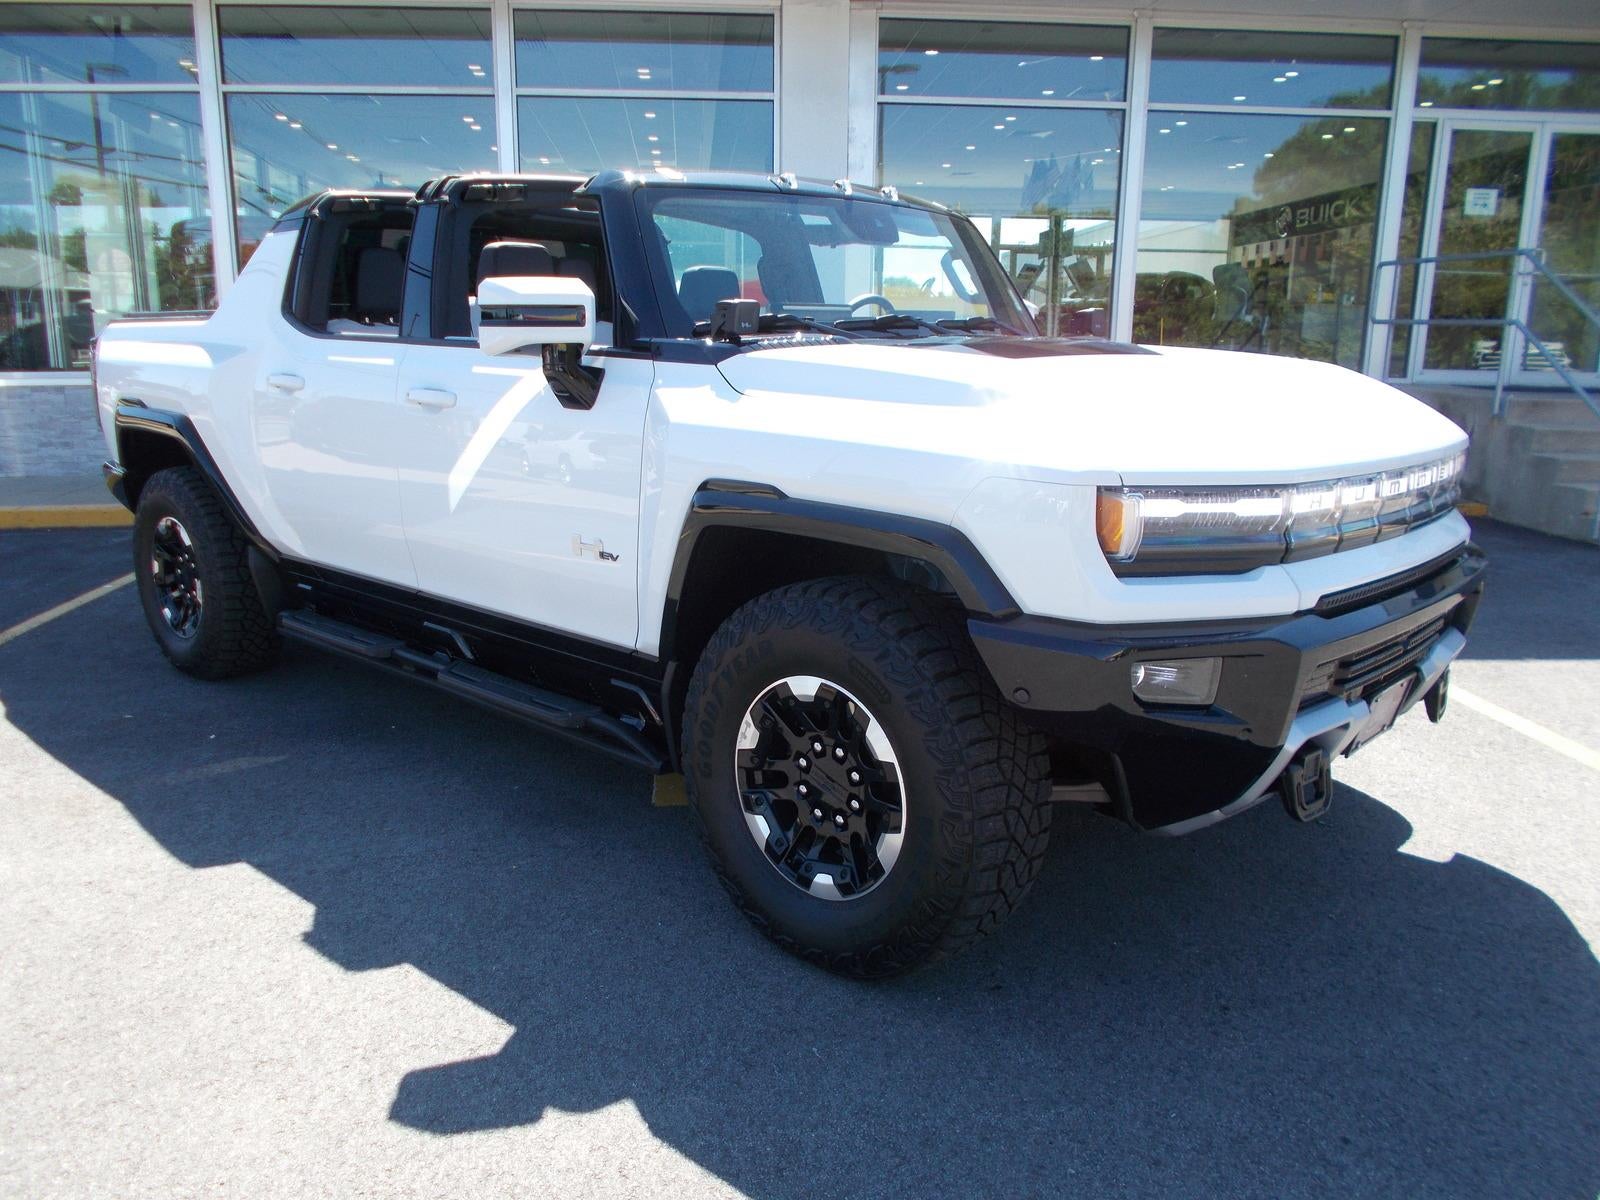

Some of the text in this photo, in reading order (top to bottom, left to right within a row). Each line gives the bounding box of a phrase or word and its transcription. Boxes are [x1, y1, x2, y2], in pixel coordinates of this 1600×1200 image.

[1296, 197, 1361, 228] BUICK
[1309, 464, 1452, 509] HUMME
[698, 639, 775, 779] GOODYEAR
